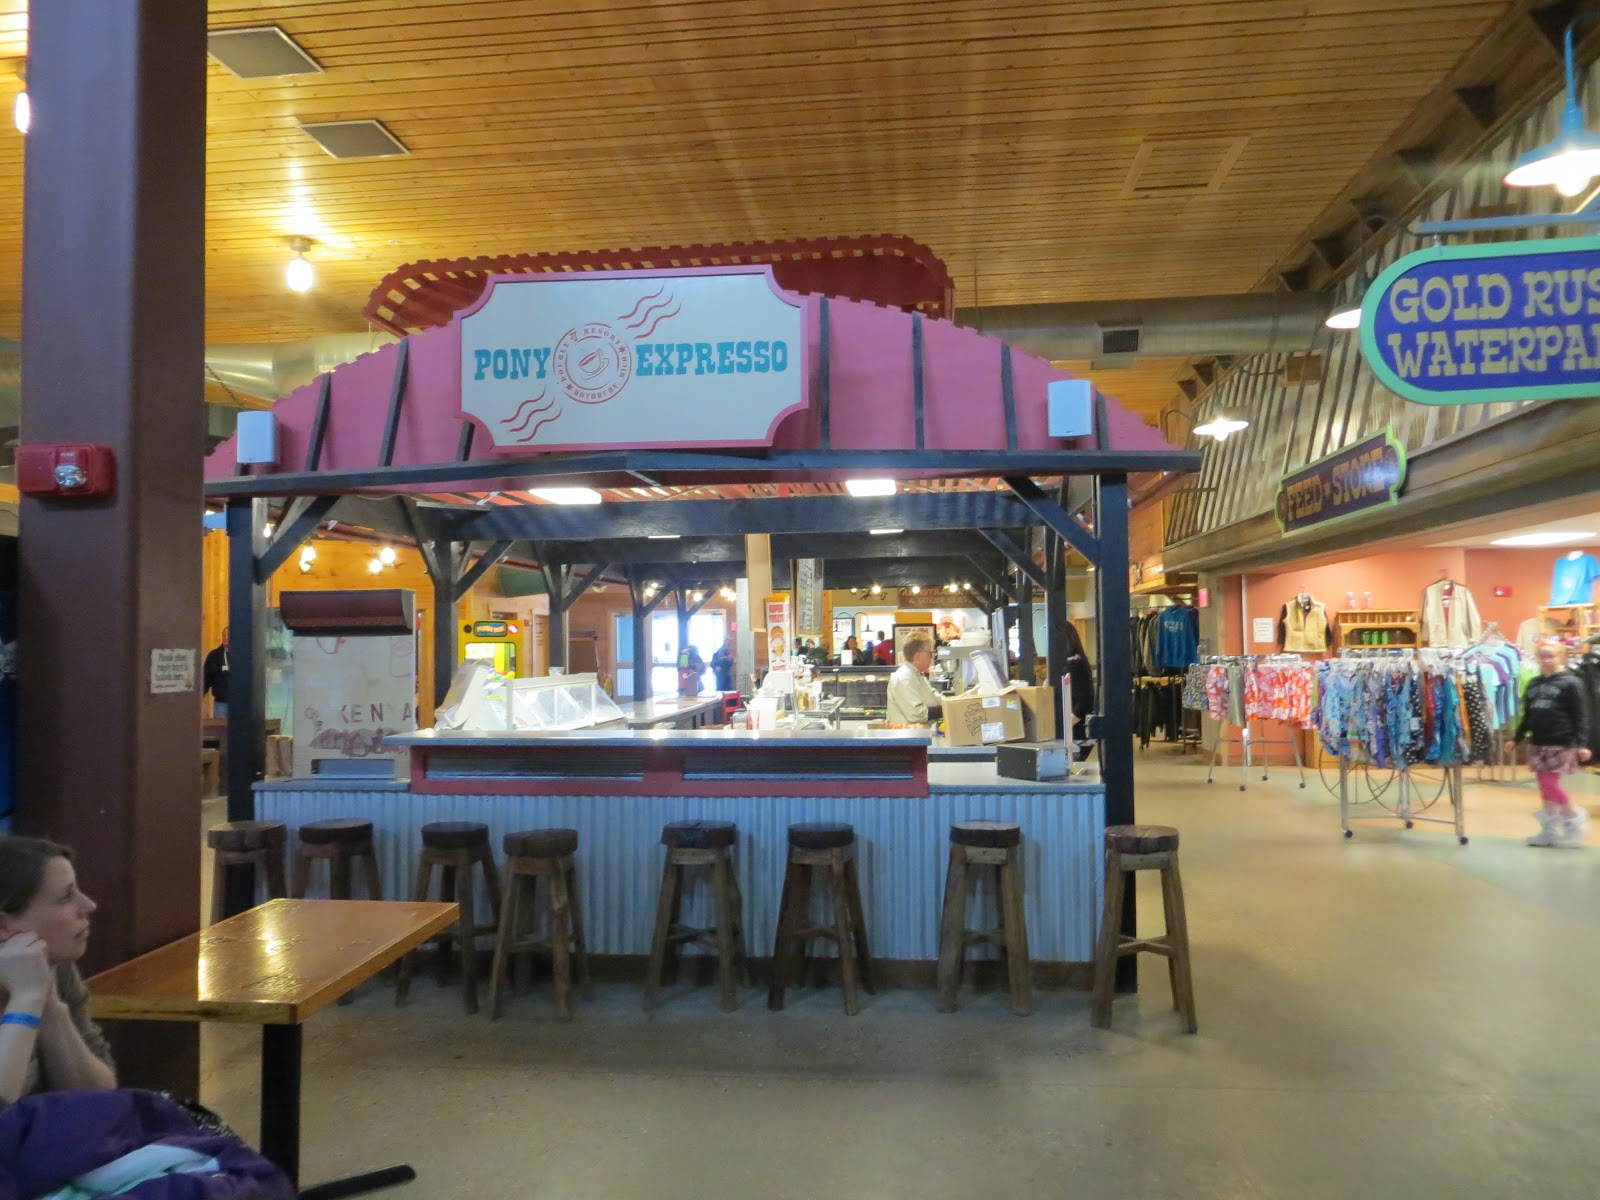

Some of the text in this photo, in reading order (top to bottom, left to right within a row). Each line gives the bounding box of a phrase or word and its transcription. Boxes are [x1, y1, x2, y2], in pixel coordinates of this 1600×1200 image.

[1389, 273, 1512, 324] GOLD
[474, 340, 788, 381] PONY EXPRESSO
[1286, 474, 1323, 521] FEED
